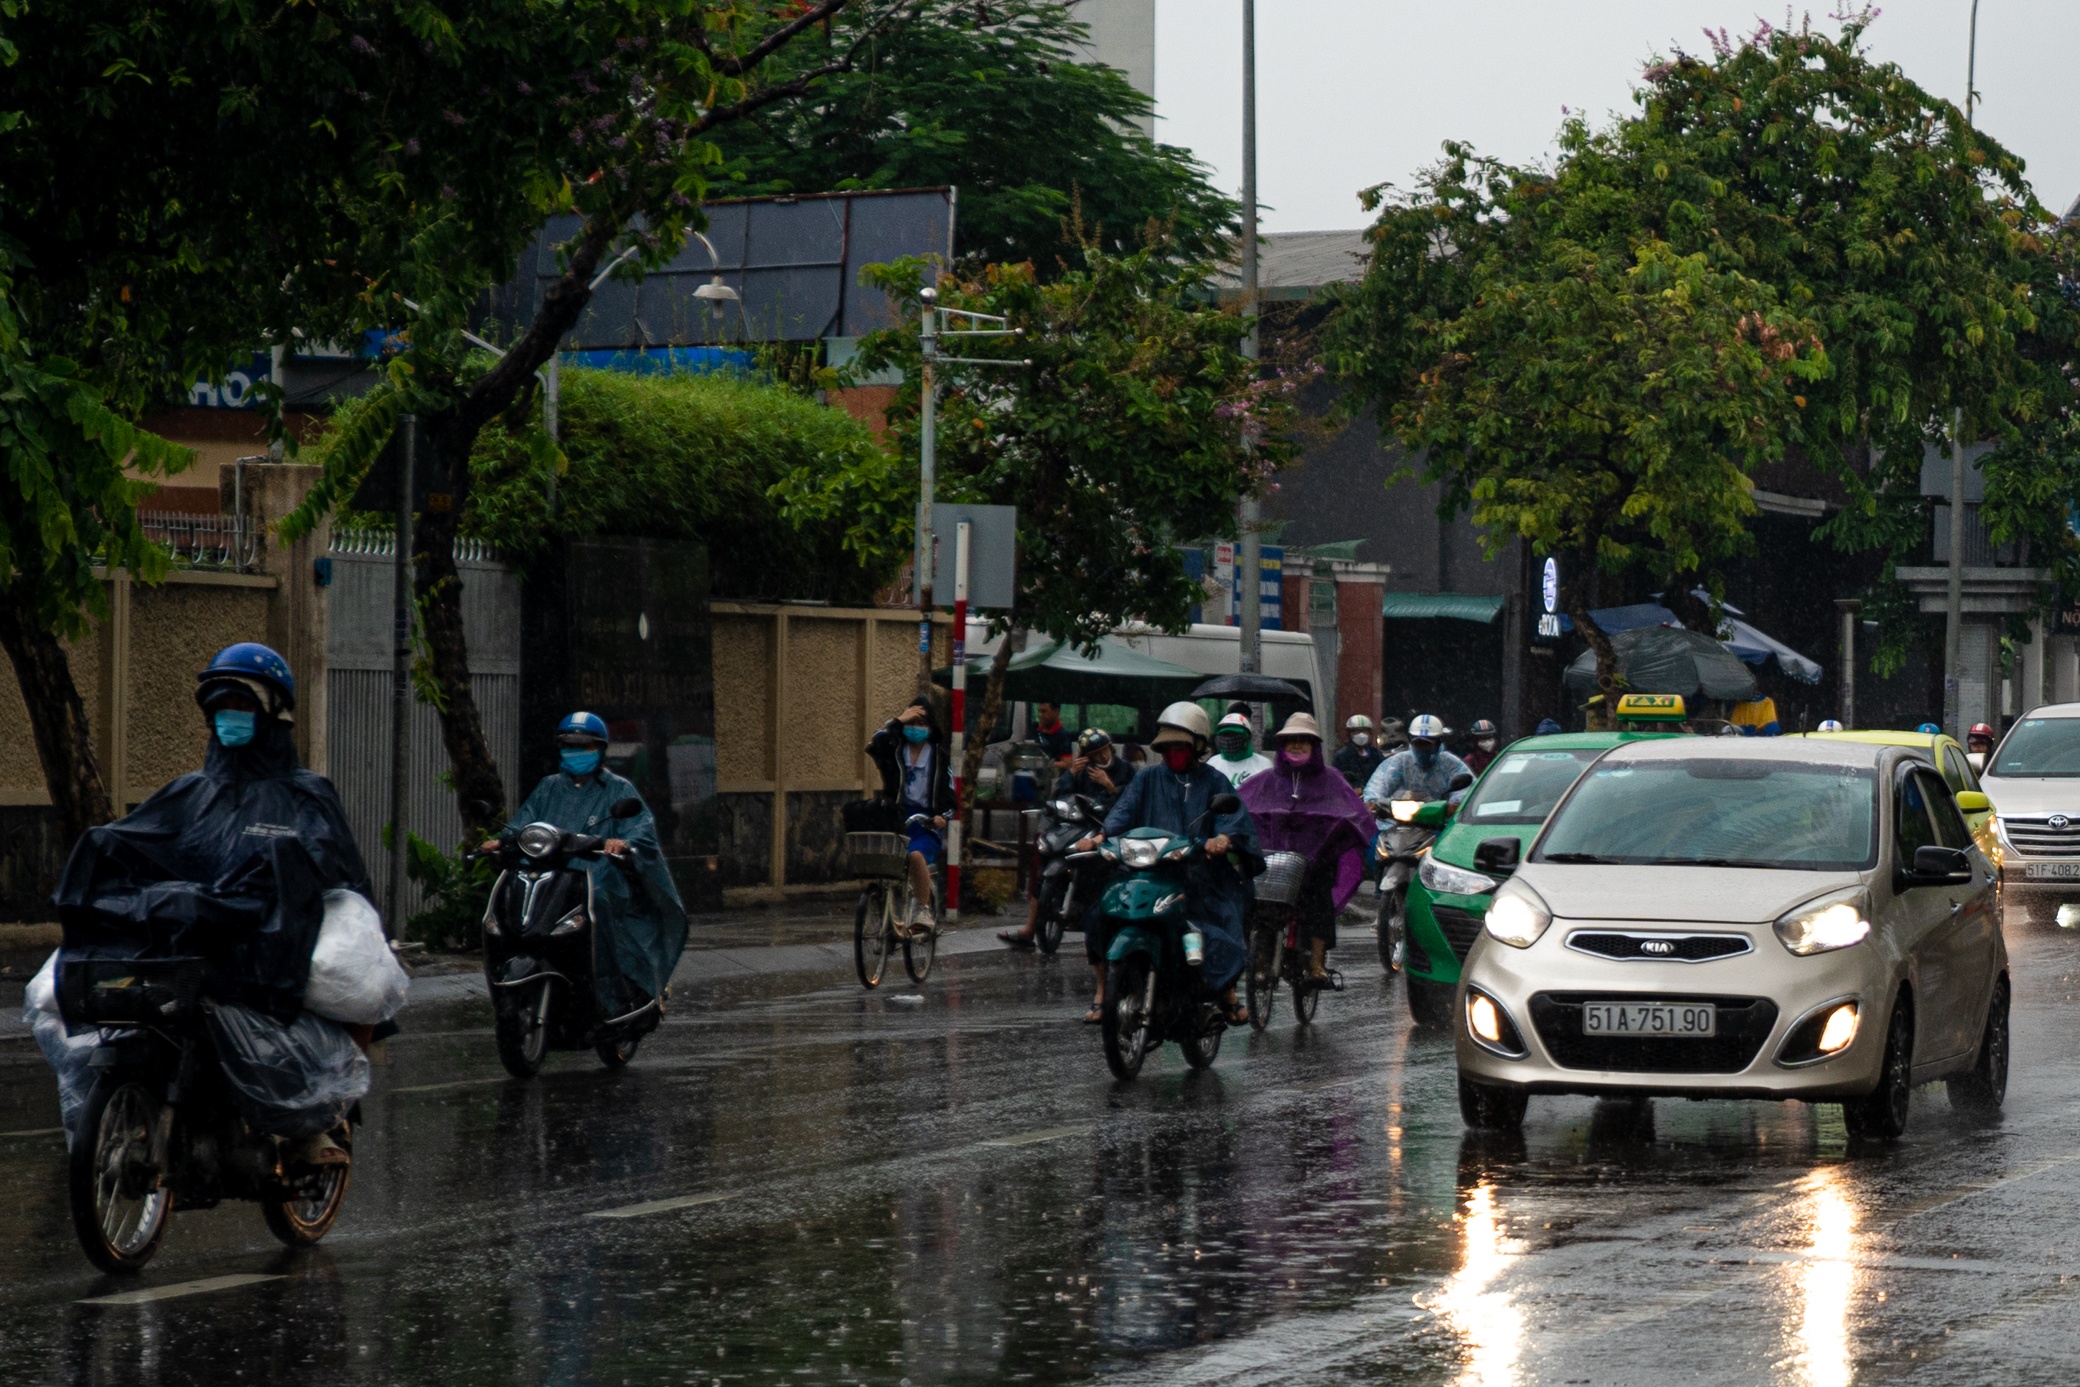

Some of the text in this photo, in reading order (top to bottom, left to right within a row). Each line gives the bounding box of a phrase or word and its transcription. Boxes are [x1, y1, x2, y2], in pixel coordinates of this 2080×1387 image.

[1627, 696, 1672, 706] TAXI
[1645, 942, 1669, 952] KIA
[1588, 1007, 1710, 1032] 51A-751.90
